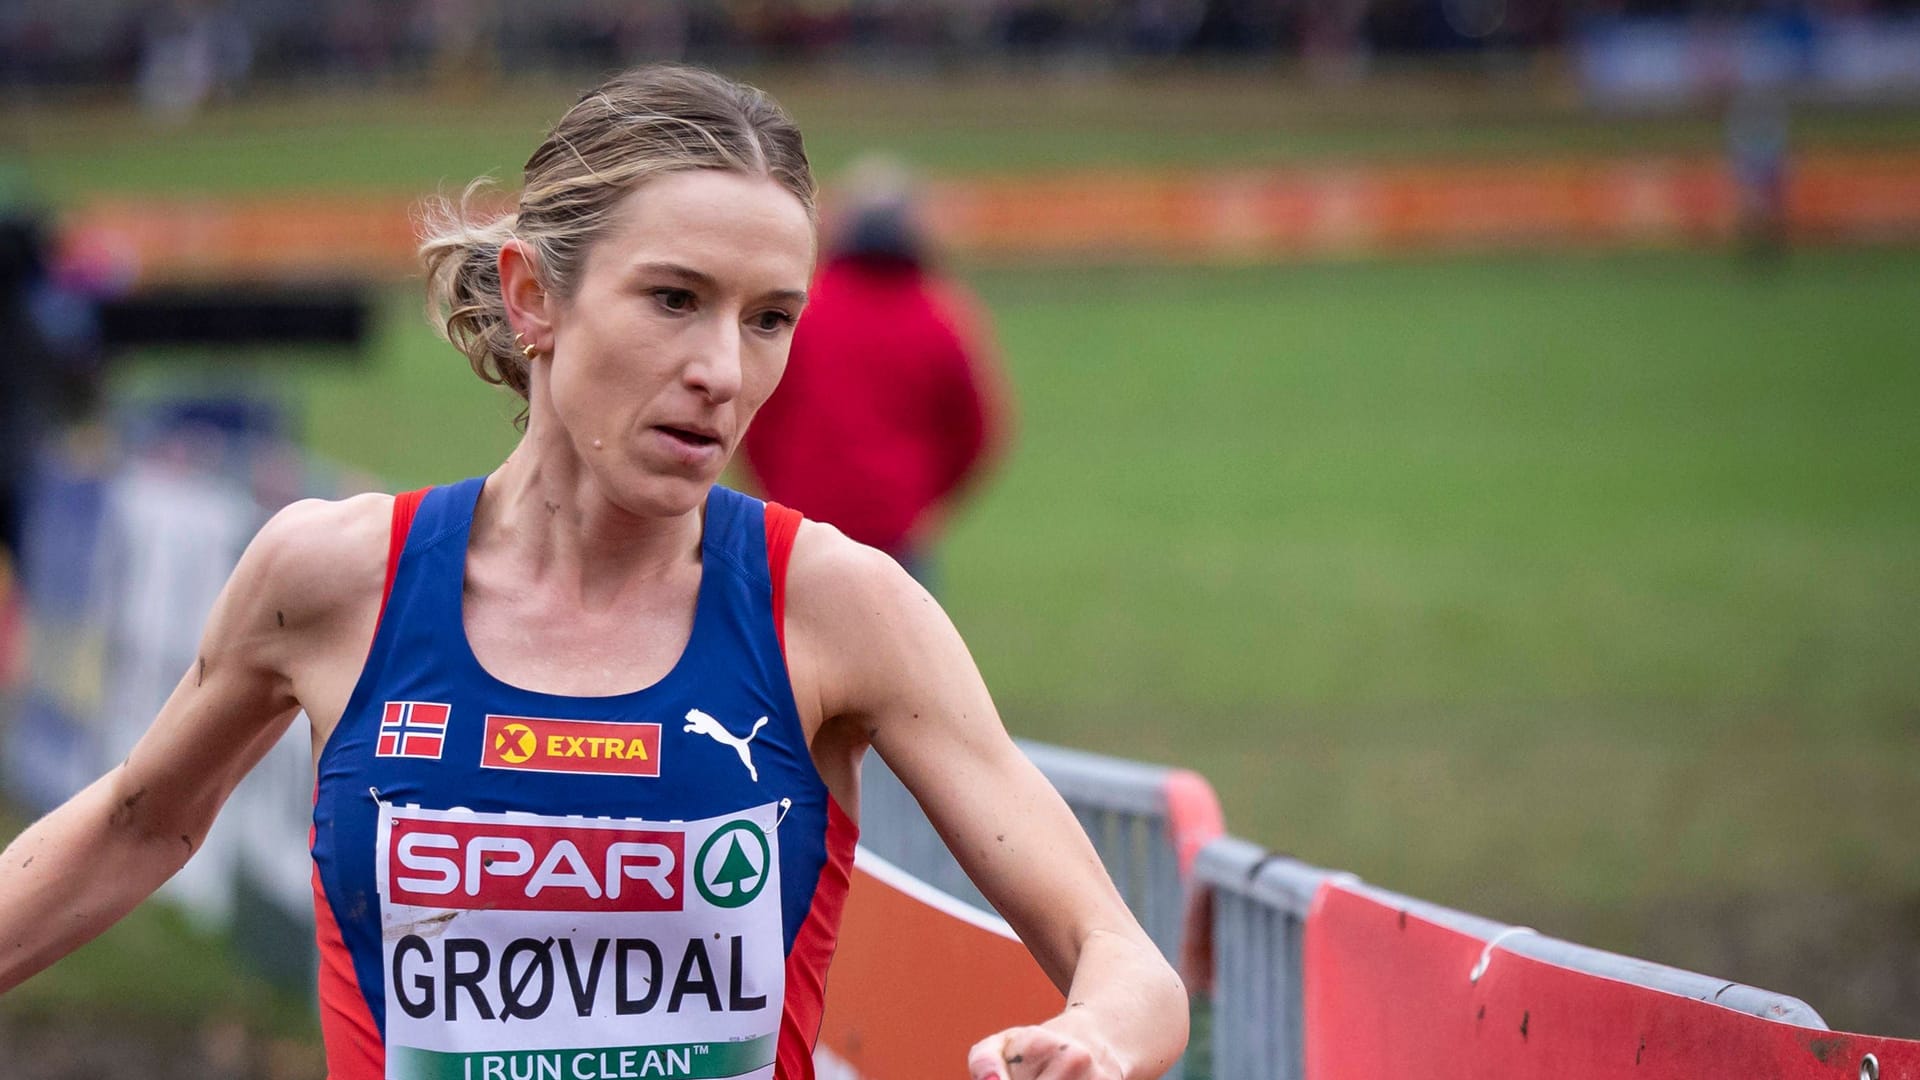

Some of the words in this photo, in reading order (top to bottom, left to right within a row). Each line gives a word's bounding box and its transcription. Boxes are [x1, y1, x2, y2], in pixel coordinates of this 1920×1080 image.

[547, 735, 649, 760] EXTRA
[397, 832, 676, 899] SPAR
[392, 934, 768, 1023] GRØVDAL
[483, 1054, 562, 1080] RUN
